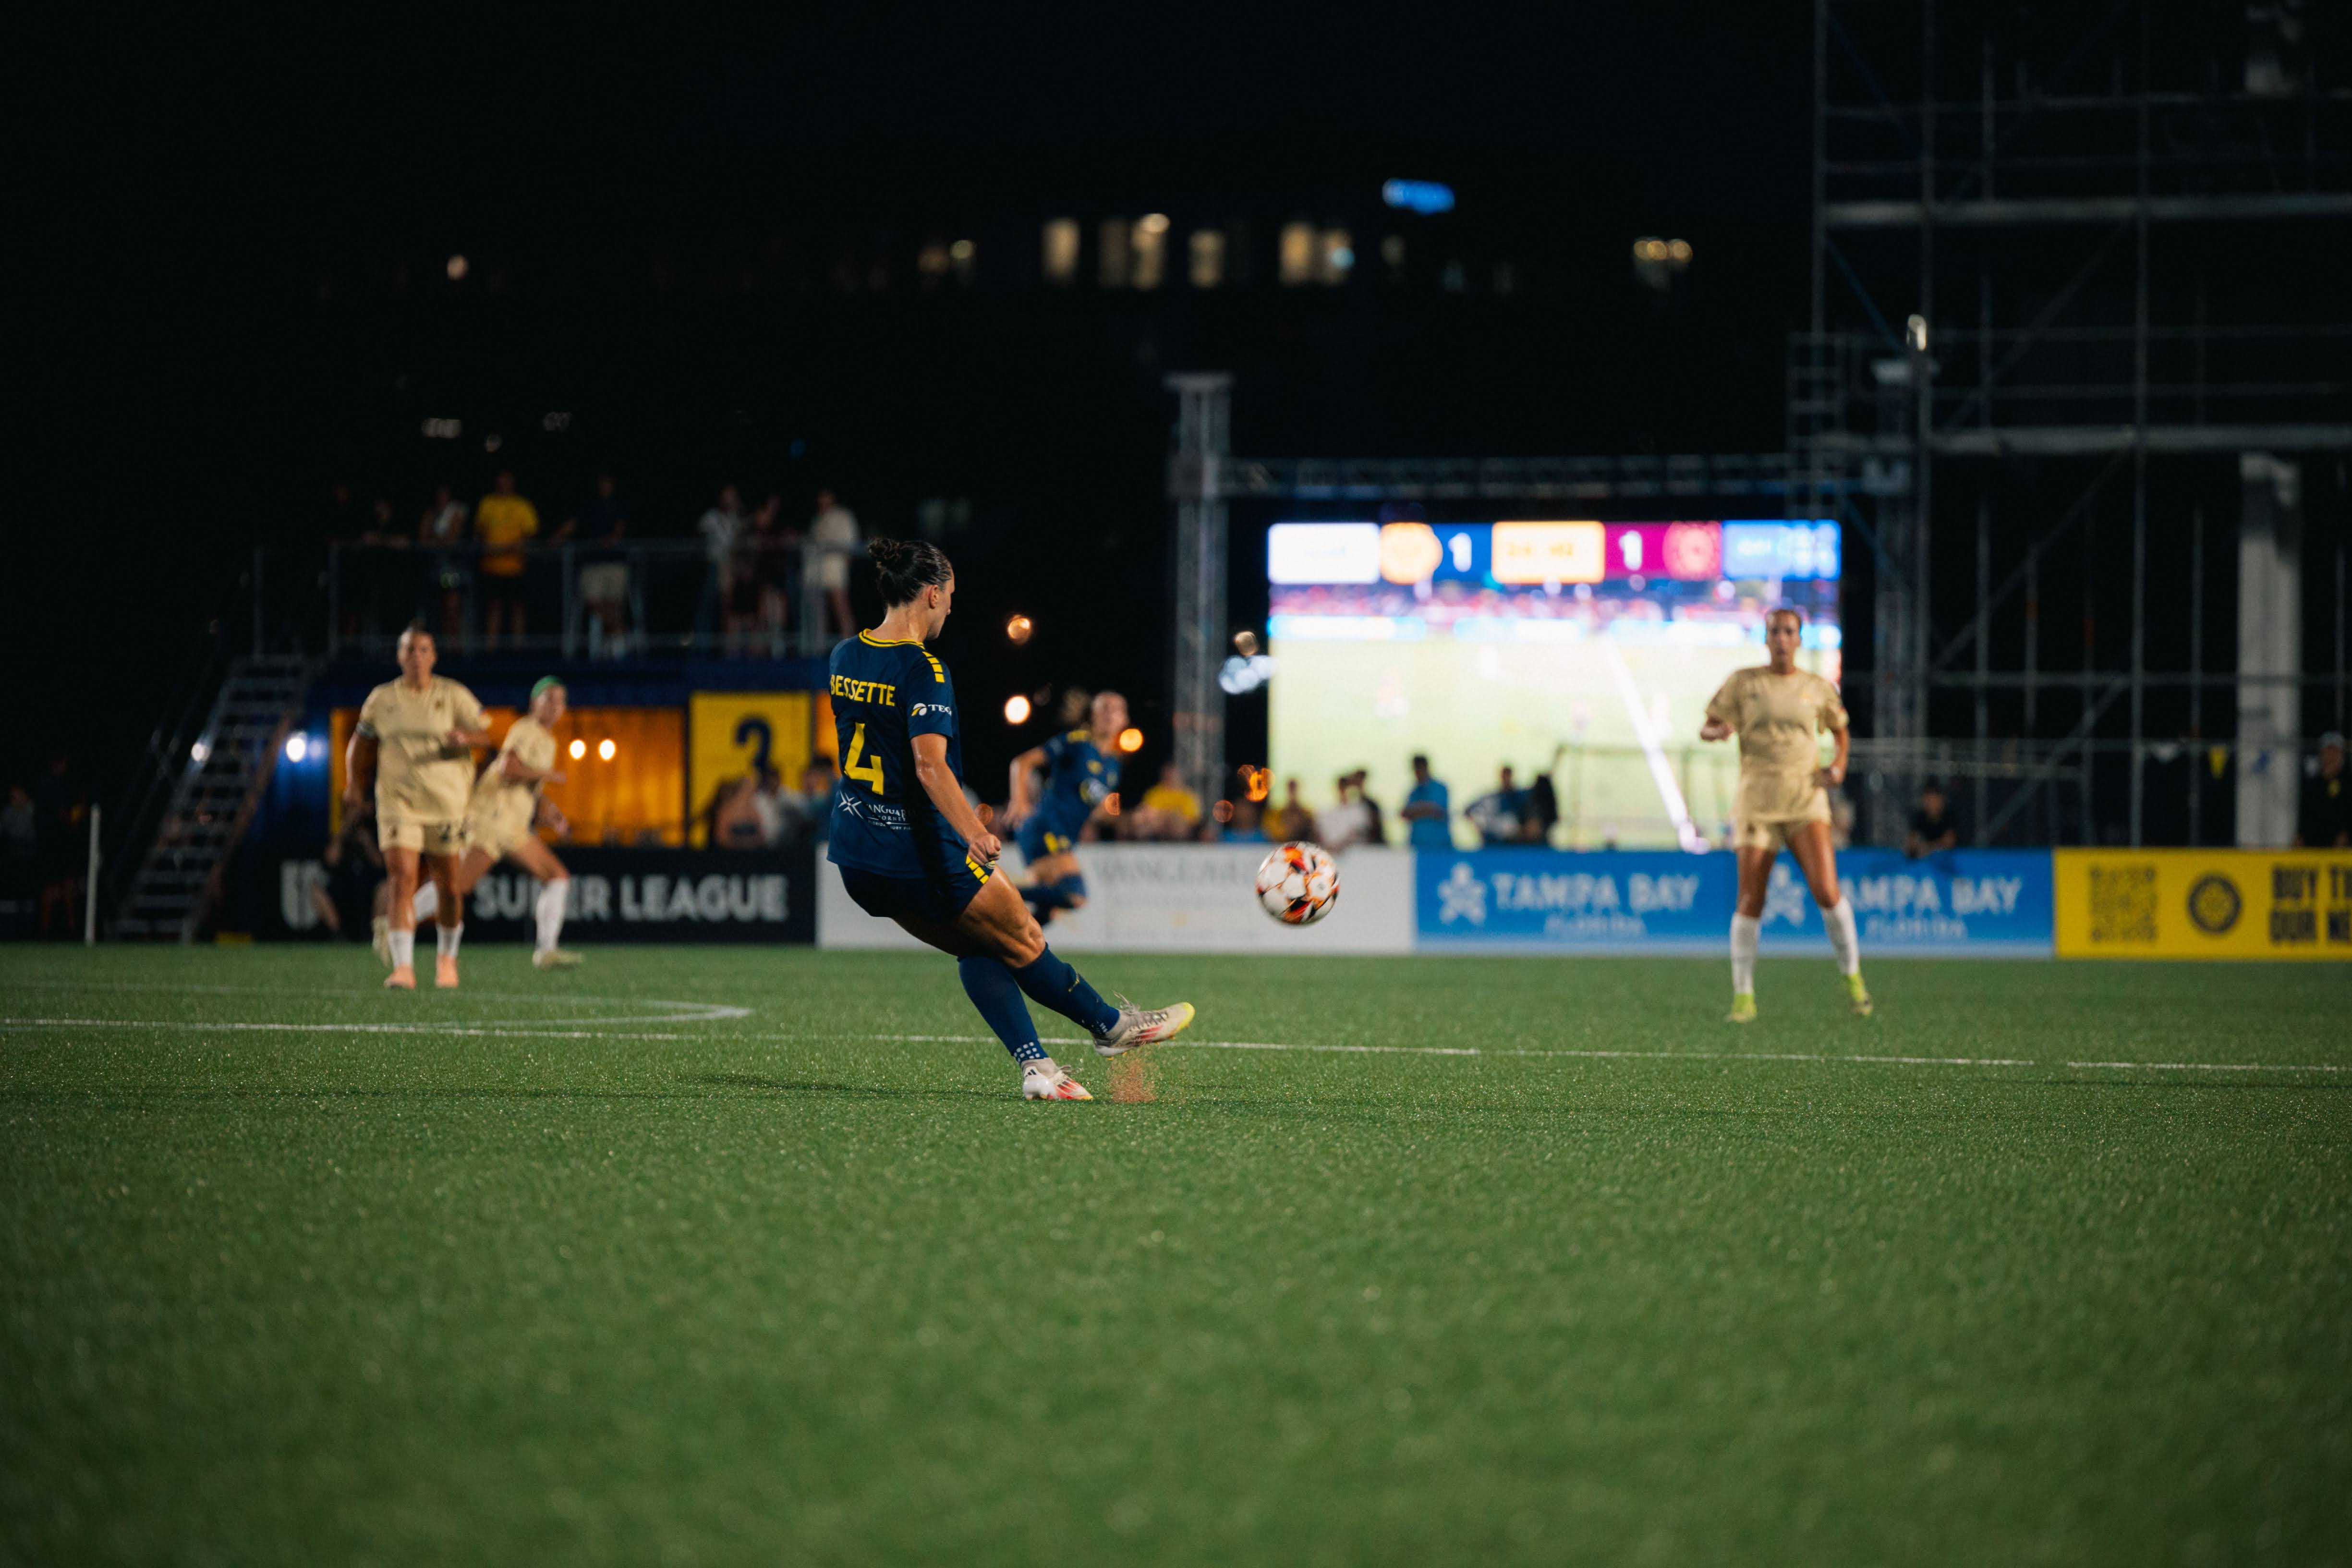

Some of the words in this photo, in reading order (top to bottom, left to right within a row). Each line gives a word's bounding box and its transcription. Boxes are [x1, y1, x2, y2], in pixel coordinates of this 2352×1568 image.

[1448, 532, 1472, 572] 1
[1619, 530, 1642, 571] 1
[830, 674, 896, 706] BESSETTE
[844, 722, 884, 796] 4
[473, 874, 611, 921] SUER
[620, 874, 789, 921] LEAGUE
[1491, 872, 1620, 912] TAMPA
[1628, 872, 1700, 912] BAY
[1839, 874, 1941, 912] AMPA
[1951, 875, 2022, 914] BAY
[2272, 866, 2318, 901] BUY
